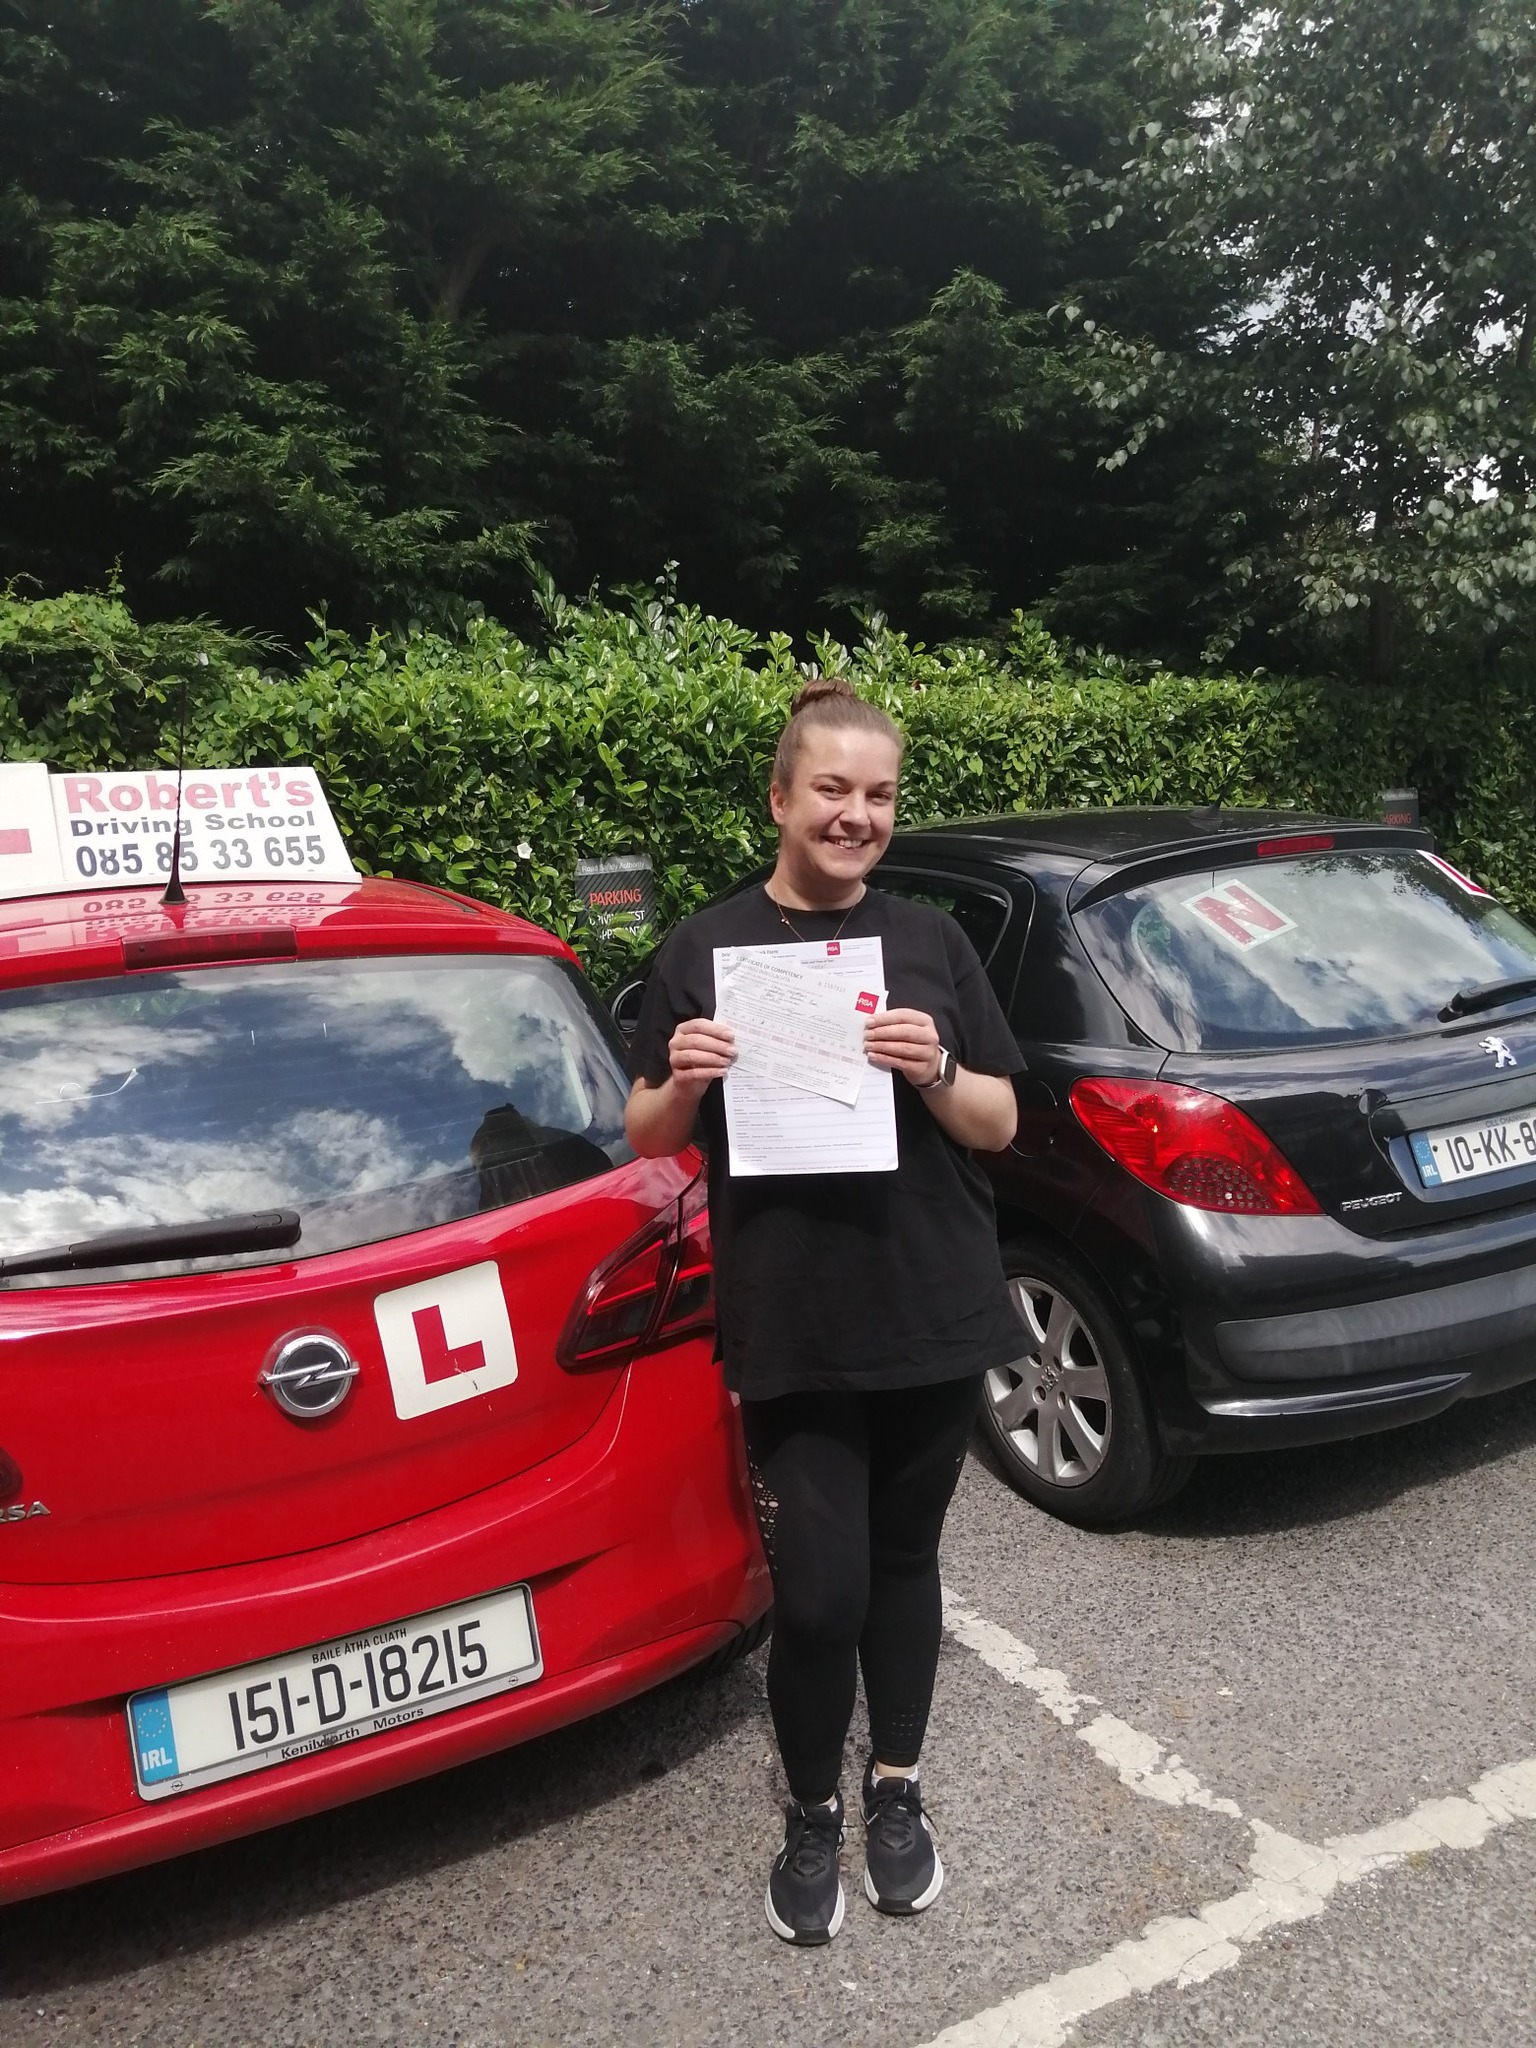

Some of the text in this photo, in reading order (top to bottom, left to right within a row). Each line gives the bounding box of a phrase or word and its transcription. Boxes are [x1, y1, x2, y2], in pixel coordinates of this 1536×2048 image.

[63, 771, 315, 814] Robert's
[70, 810, 315, 837] Driving School
[76, 835, 326, 877] 085 85 33 655
[589, 888, 642, 906] PARKING
[1192, 884, 1289, 945] N
[858, 997, 873, 1008] RSA
[1422, 1165, 1437, 1178] IRL
[1341, 1191, 1402, 1212] PEUGEOT
[411, 1304, 487, 1385] L
[311, 1647, 341, 1664] BAILE
[373, 1627, 407, 1646] CLIATH
[228, 1619, 488, 1751] 151-D-18215
[281, 1707, 424, 1759] Kenilworth Motors
[141, 1747, 173, 1770] IRL
